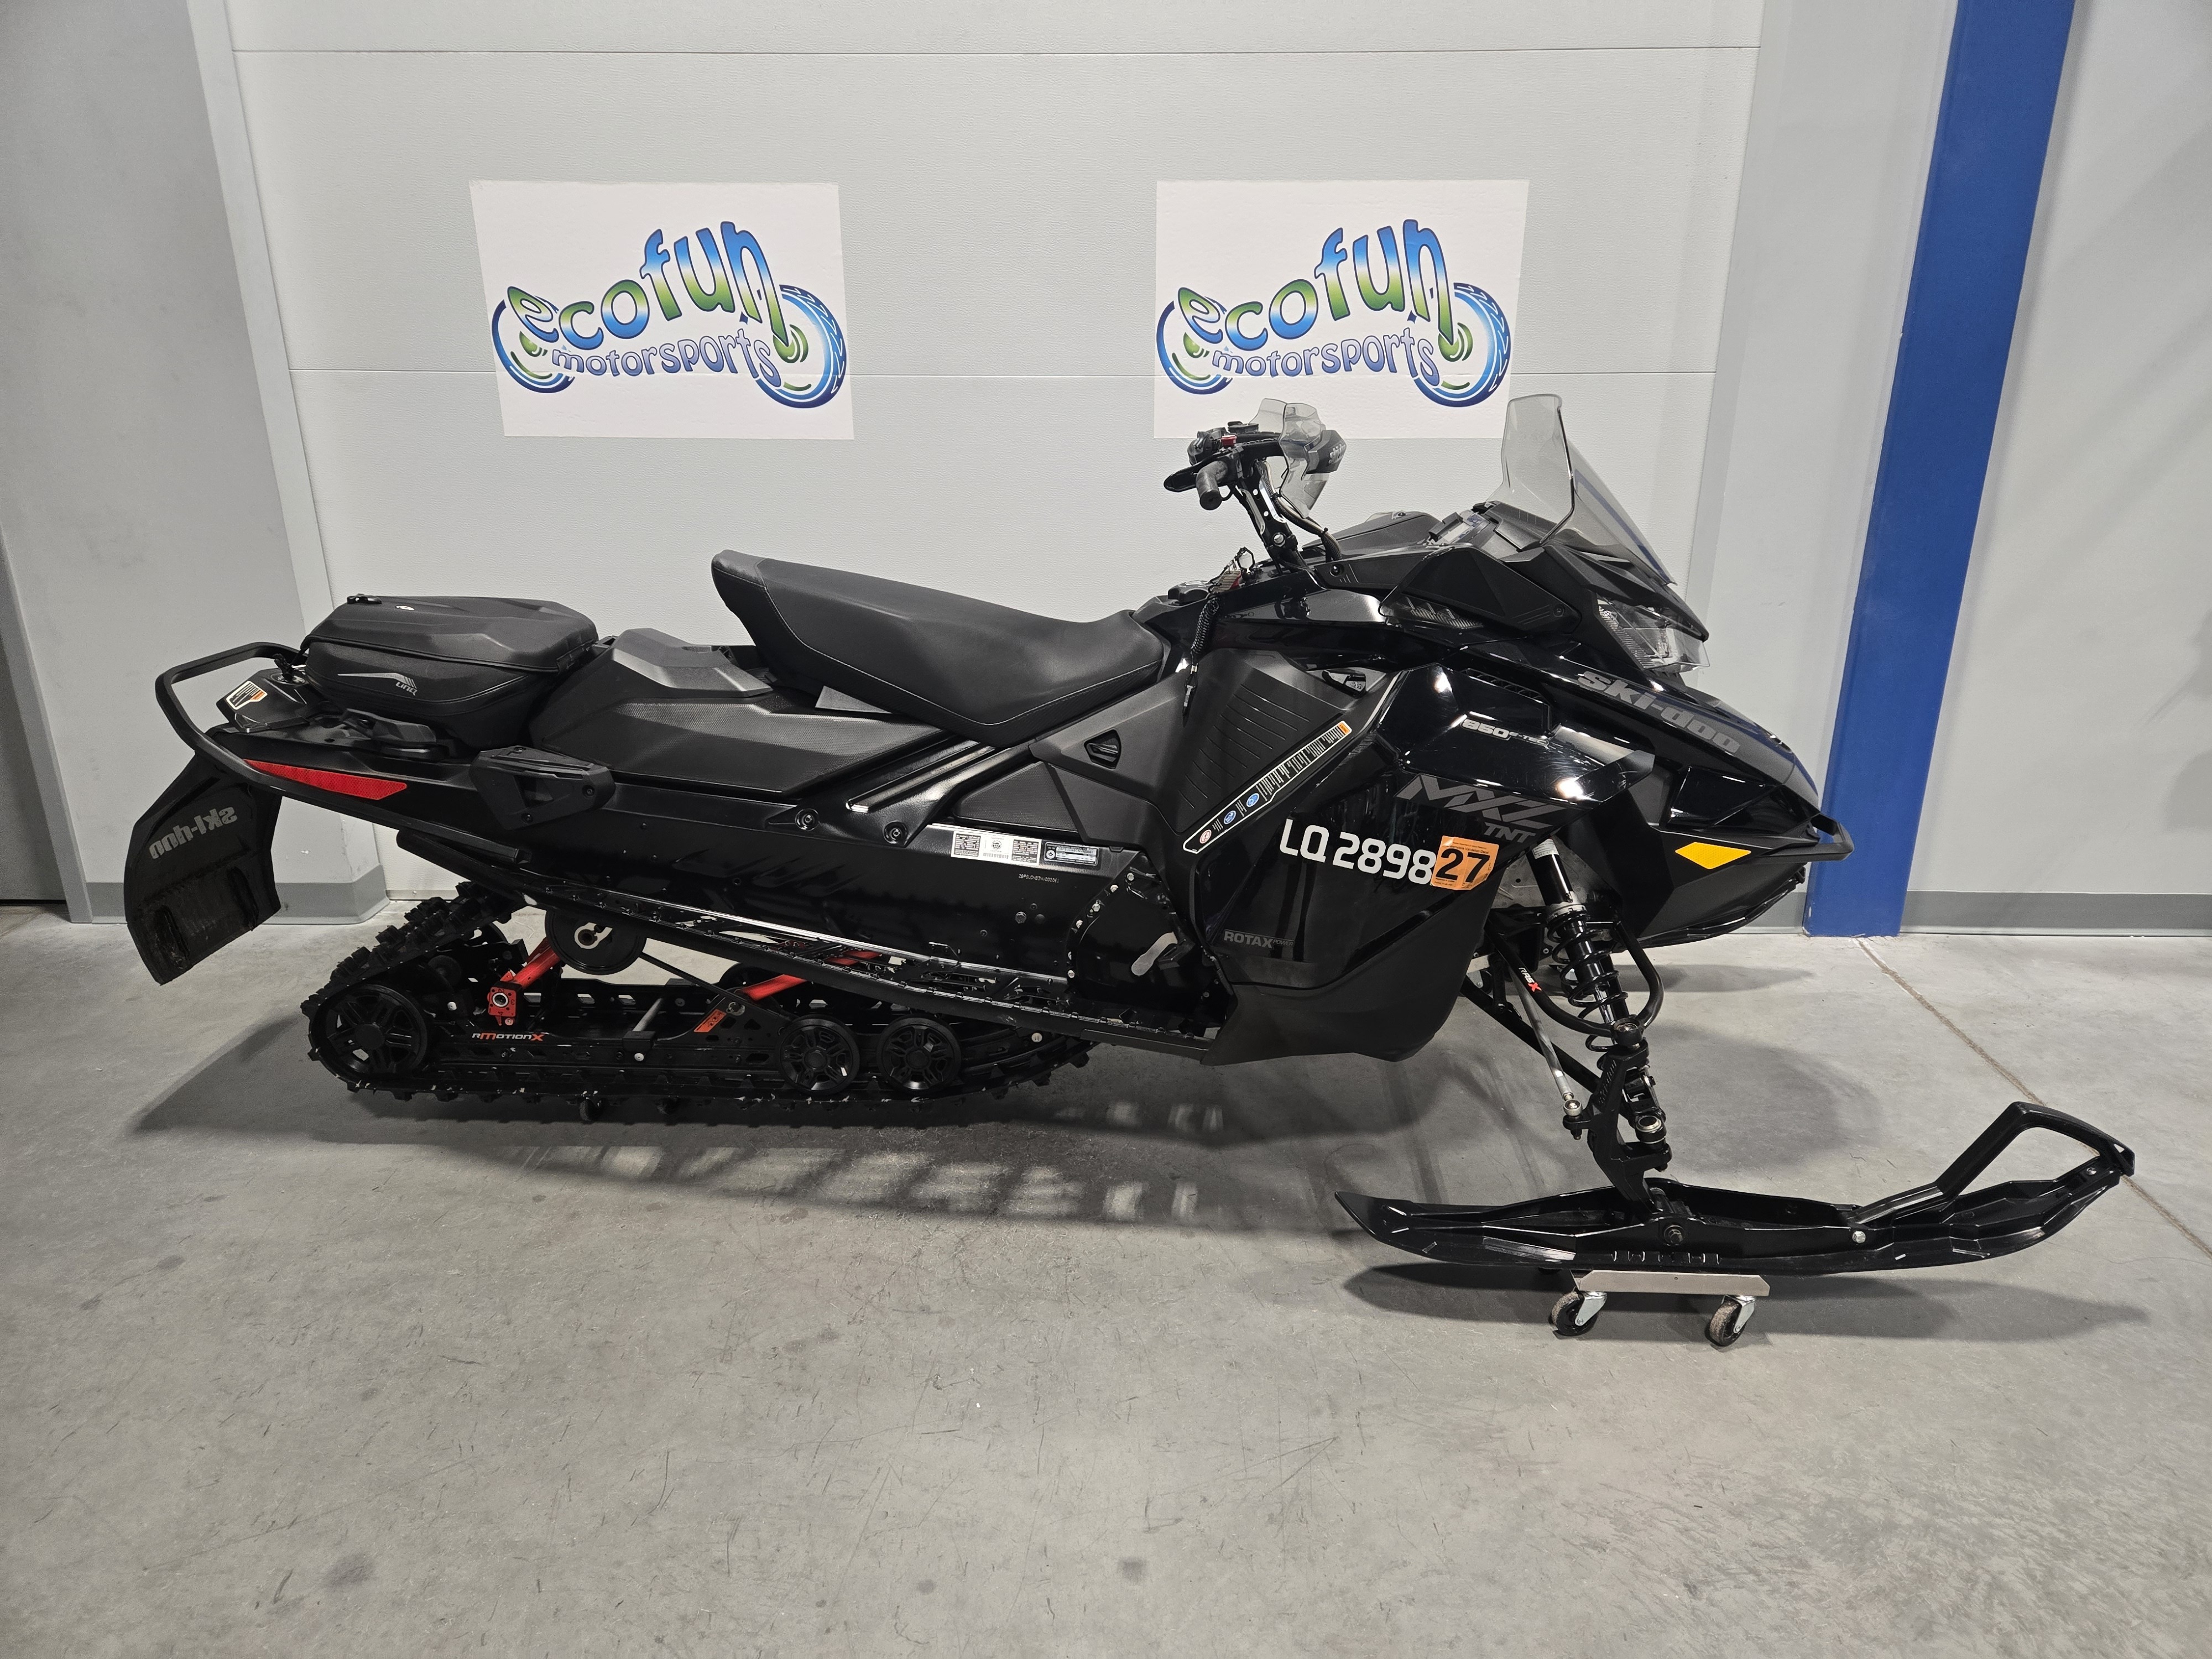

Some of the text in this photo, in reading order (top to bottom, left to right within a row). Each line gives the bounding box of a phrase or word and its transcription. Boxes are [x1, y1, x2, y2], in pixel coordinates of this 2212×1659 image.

[552, 328, 782, 387] motorsports
[1212, 327, 1441, 386] motorsports
[1462, 719, 1509, 738] 850
[1394, 774, 1567, 830] MXZ
[1280, 818, 1437, 885] LQ 2898
[1483, 822, 1536, 843] TNT
[1435, 848, 1490, 883] 27
[1224, 931, 1273, 948] ROTAX
